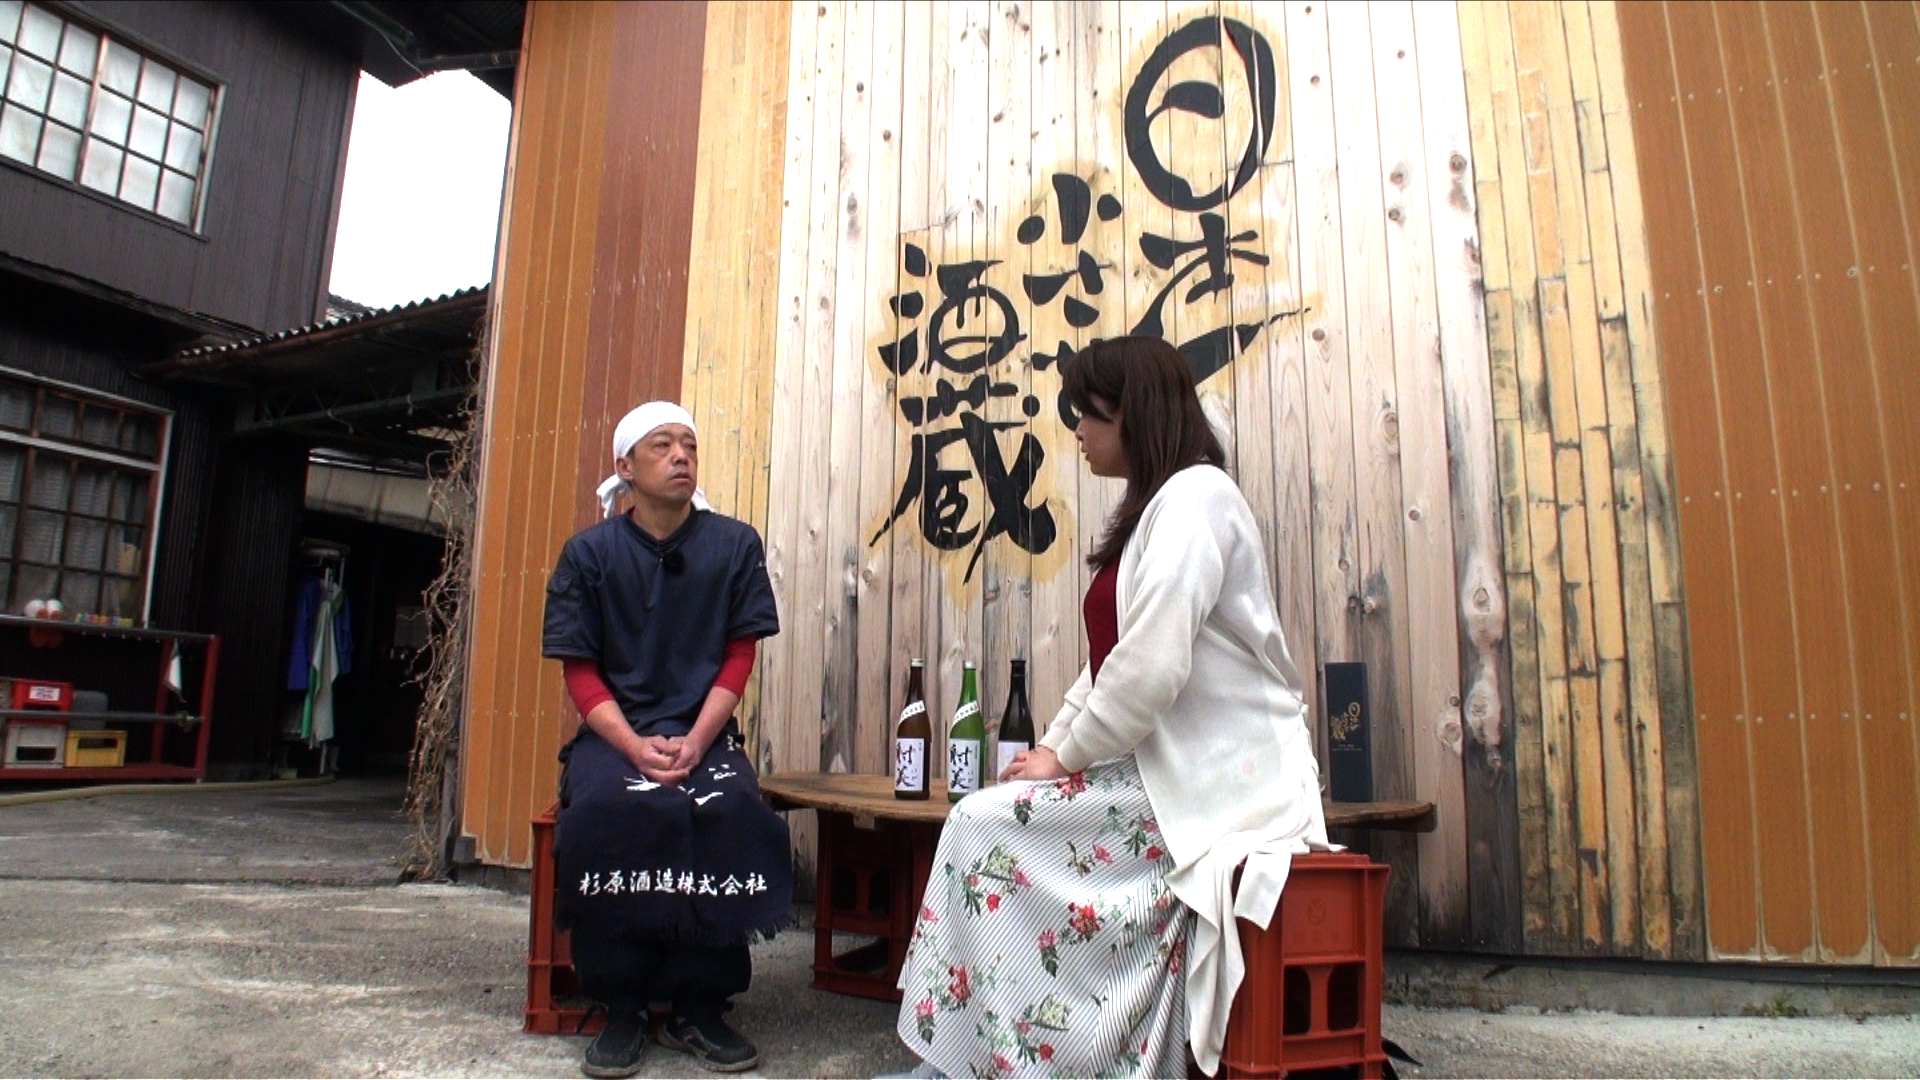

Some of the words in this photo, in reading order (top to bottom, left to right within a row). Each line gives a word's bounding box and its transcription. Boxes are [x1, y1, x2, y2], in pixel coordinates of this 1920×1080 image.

[869, 243, 1056, 586] 酒蔵
[579, 868, 768, 896] 杉原酒造株式会社
